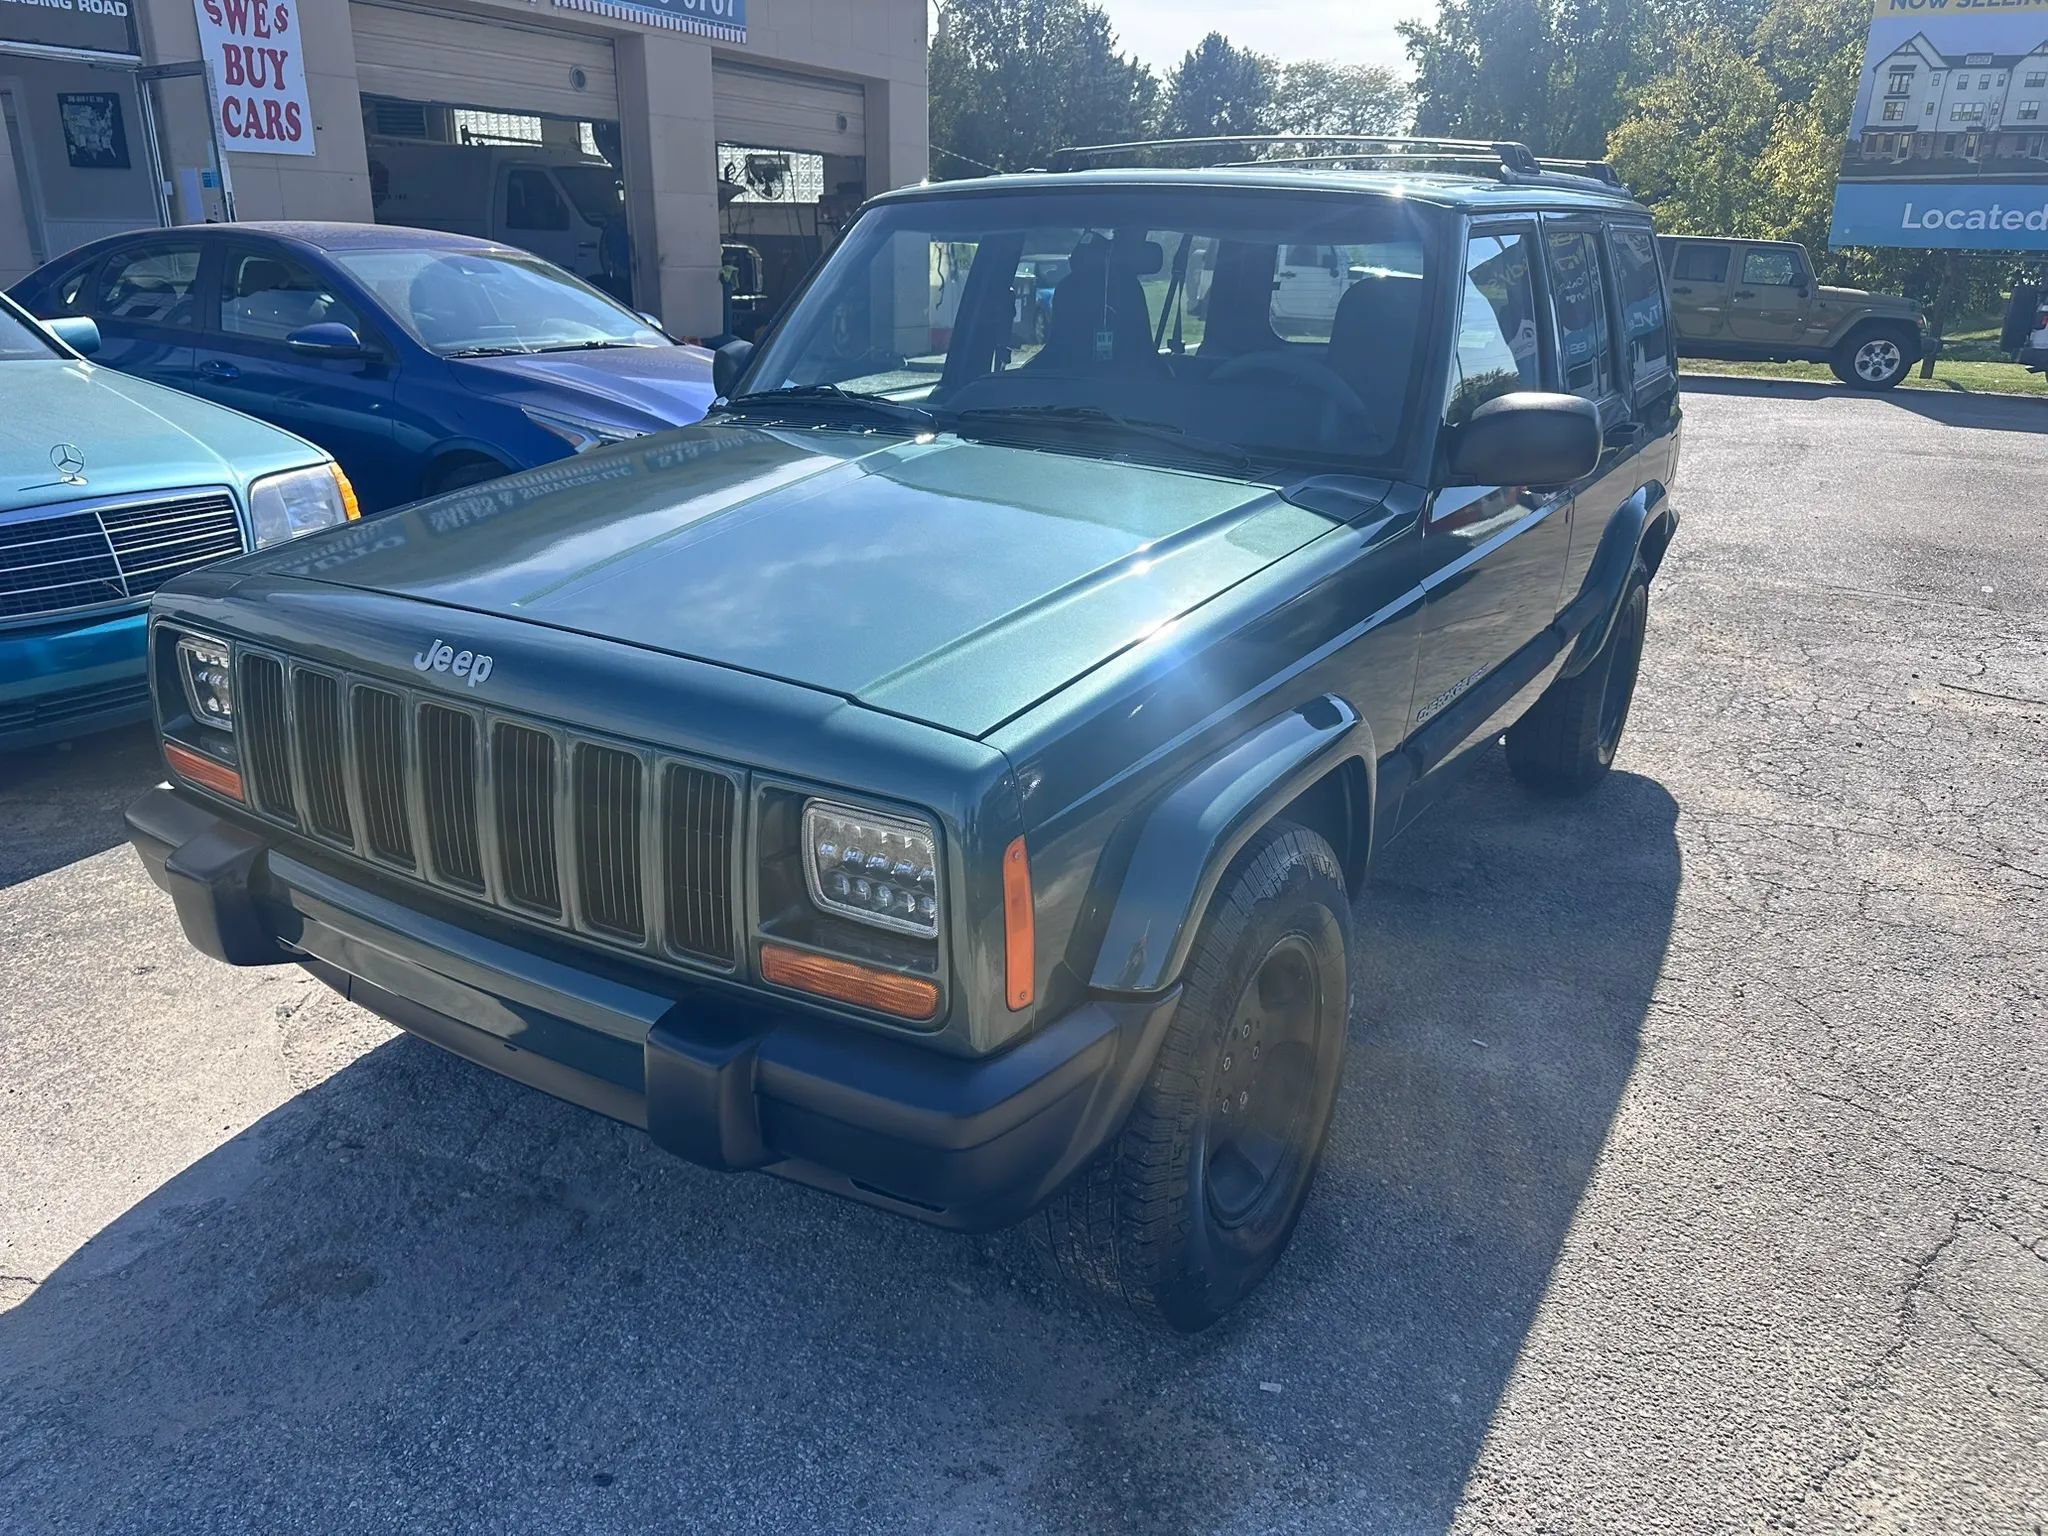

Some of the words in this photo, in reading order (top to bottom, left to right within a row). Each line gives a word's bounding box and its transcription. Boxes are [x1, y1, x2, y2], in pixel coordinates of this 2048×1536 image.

[78, 0, 128, 17] ROAD
[222, 43, 289, 91] BUY
[222, 95, 302, 142] CARS
[1901, 202, 2048, 231] Located
[414, 639, 493, 688] Jeep
